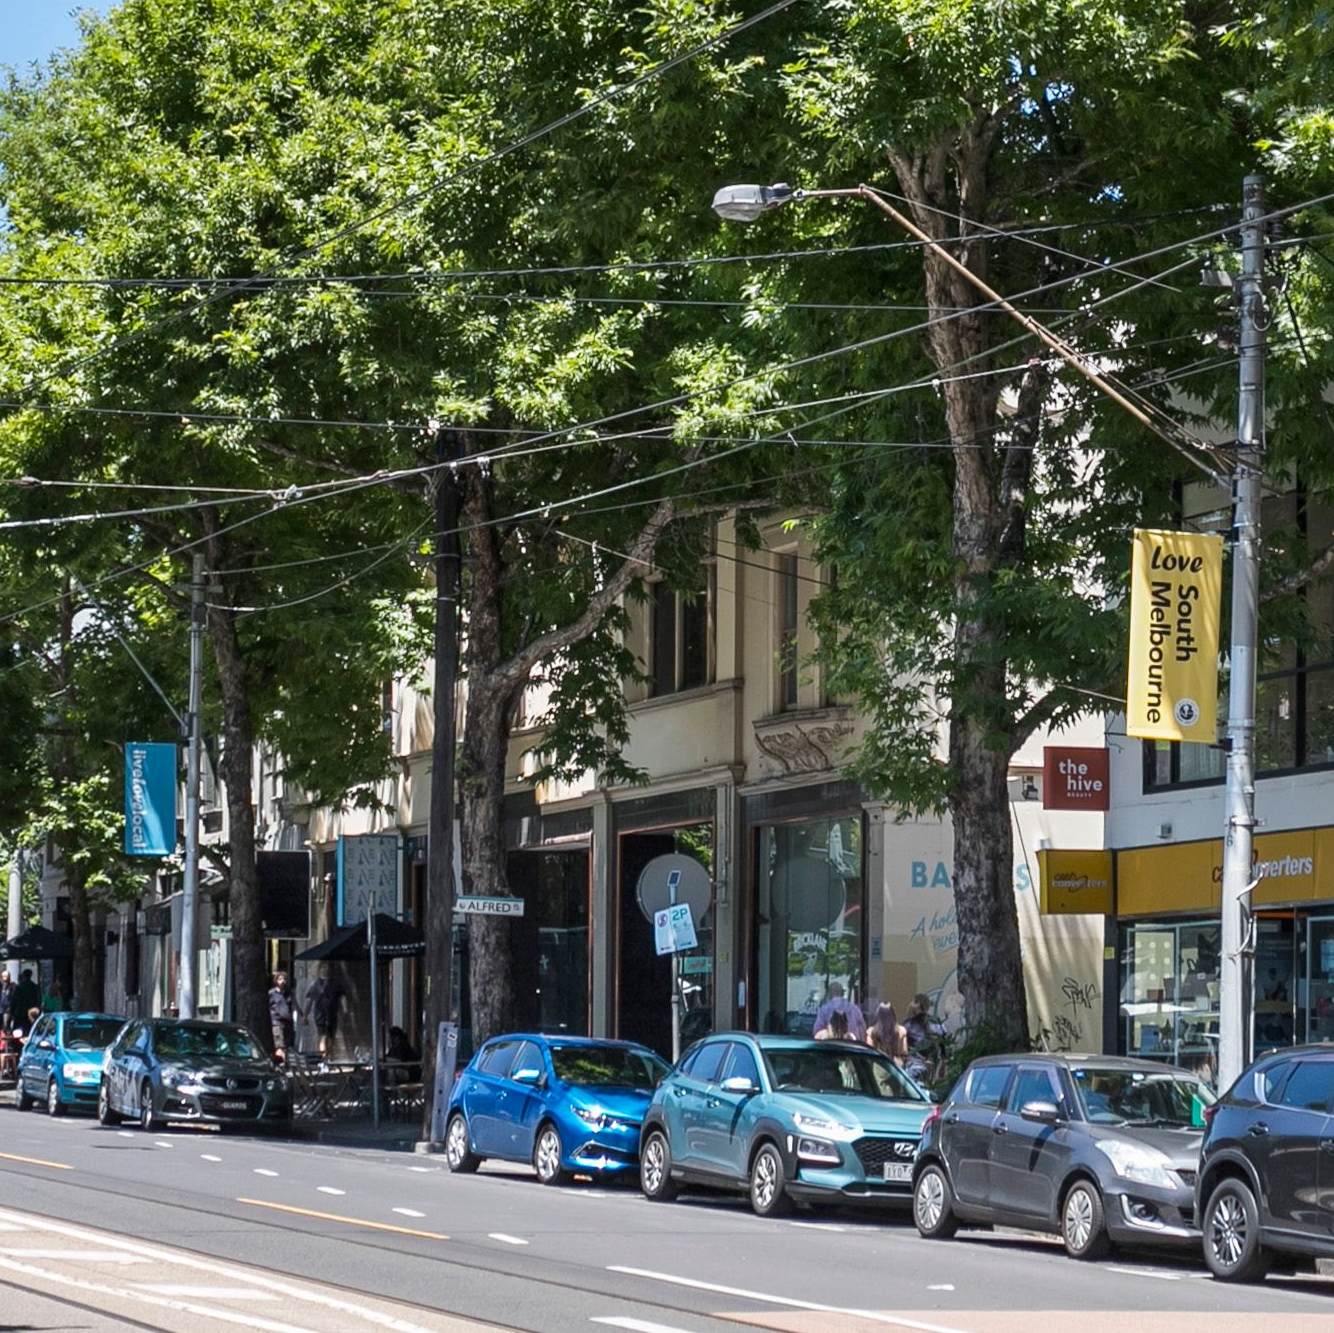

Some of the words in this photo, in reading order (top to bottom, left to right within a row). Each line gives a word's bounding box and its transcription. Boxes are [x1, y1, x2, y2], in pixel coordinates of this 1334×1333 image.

[1150, 545, 1203, 573] Love
[1175, 584, 1199, 662] South
[1146, 581, 1172, 724] Melbourne
[1058, 758, 1088, 775] the
[1067, 775, 1103, 792] hive
[467, 900, 511, 913] ALFRED
[672, 907, 688, 922] 2P
